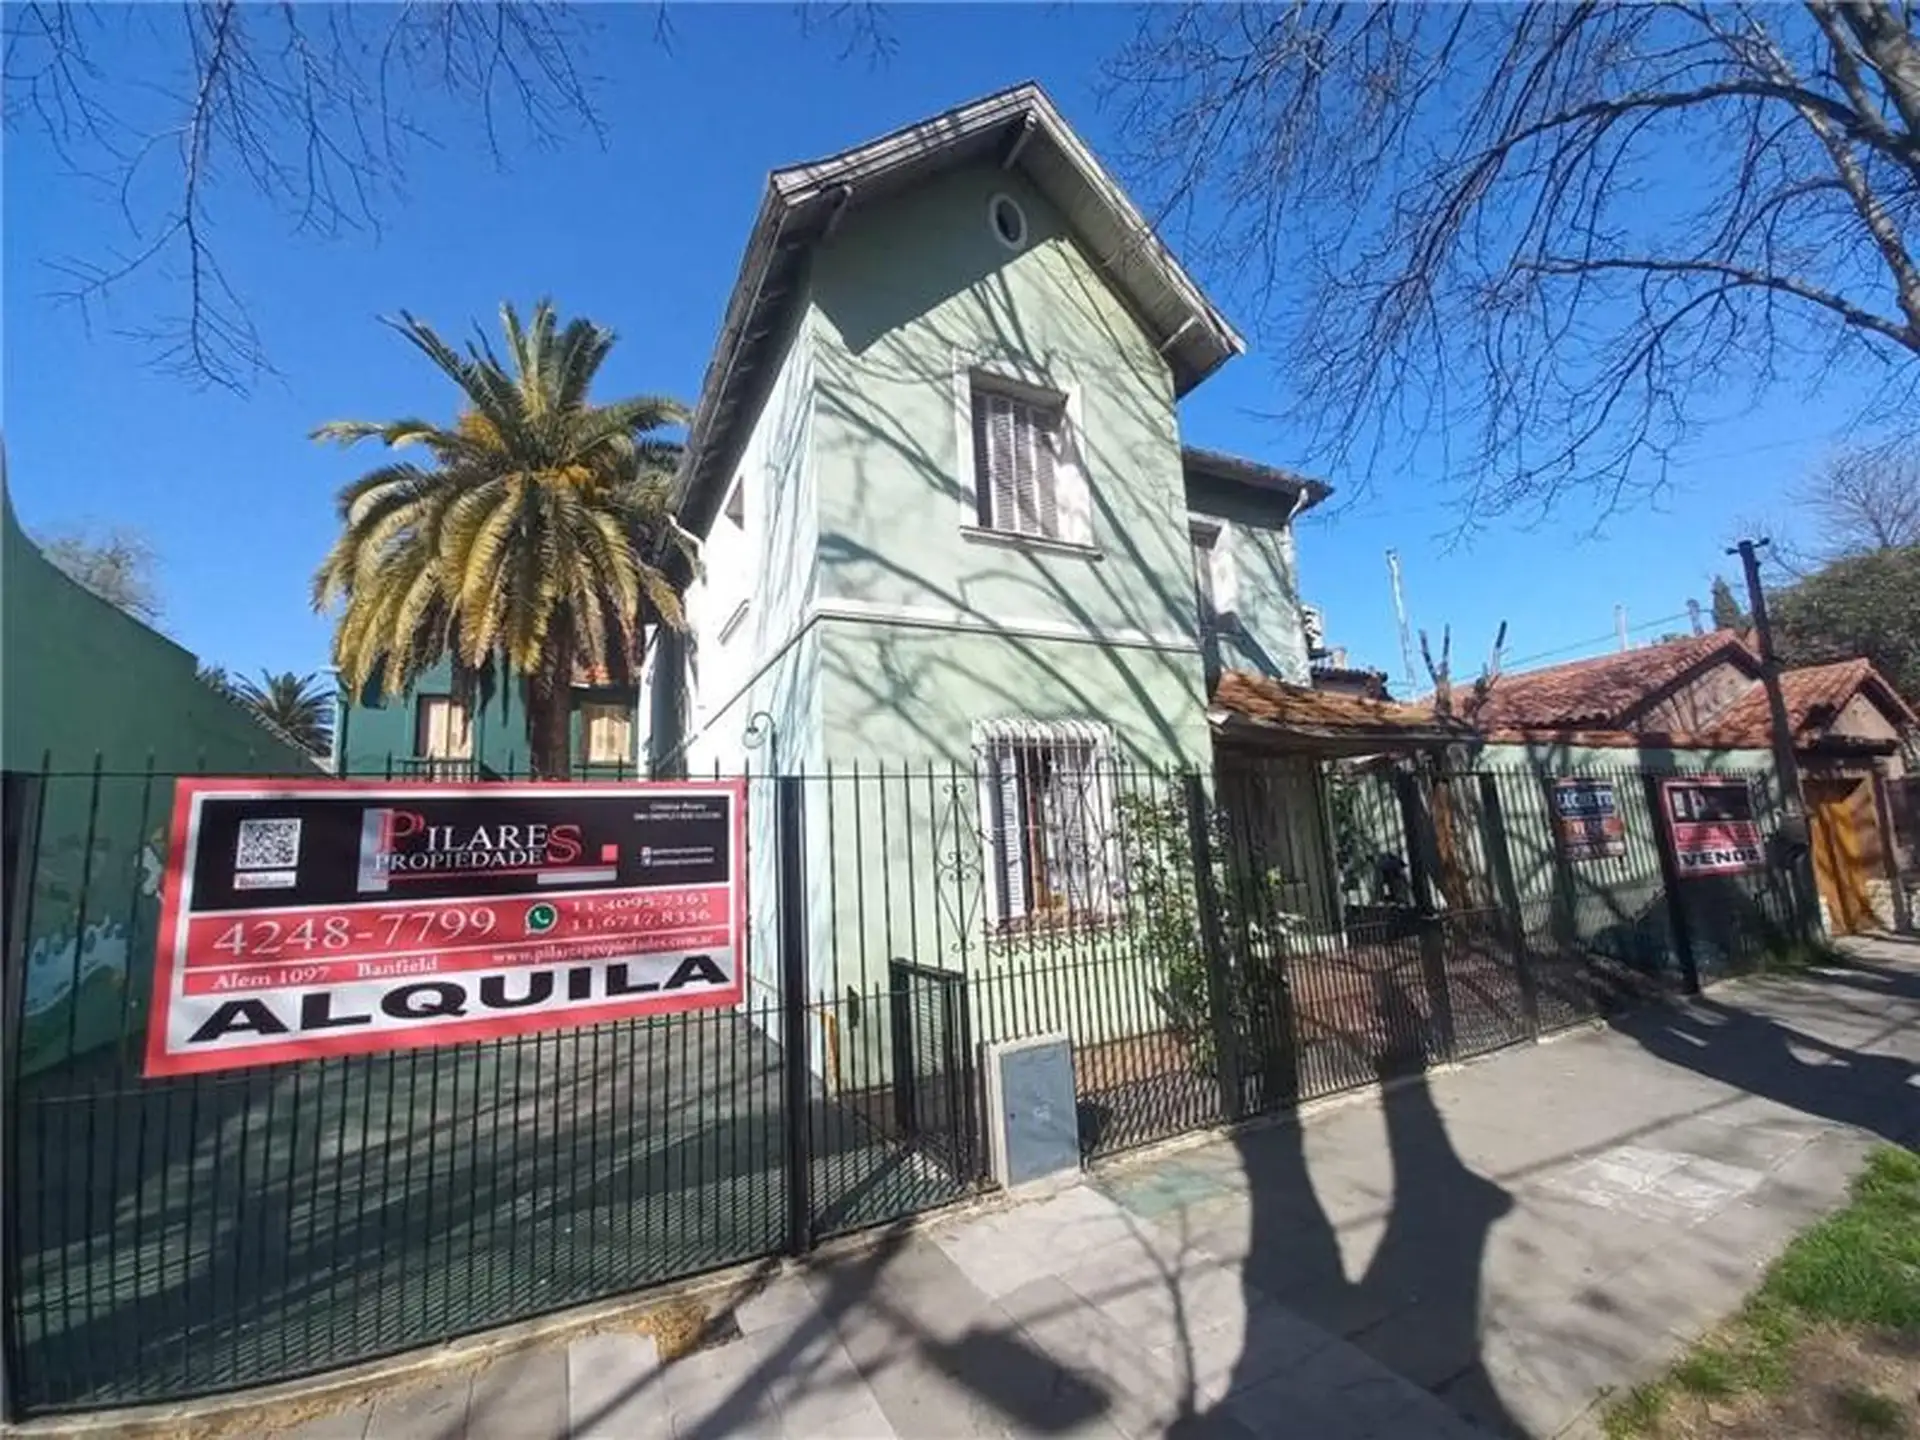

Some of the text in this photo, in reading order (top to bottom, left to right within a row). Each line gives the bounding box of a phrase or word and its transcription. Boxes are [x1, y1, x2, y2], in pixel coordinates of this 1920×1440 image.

[375, 811, 582, 863] PILARES
[213, 906, 497, 956] 4248-7799
[187, 954, 731, 1042] ALQUILA
[212, 956, 439, 990] Alem 1097 Banfield
